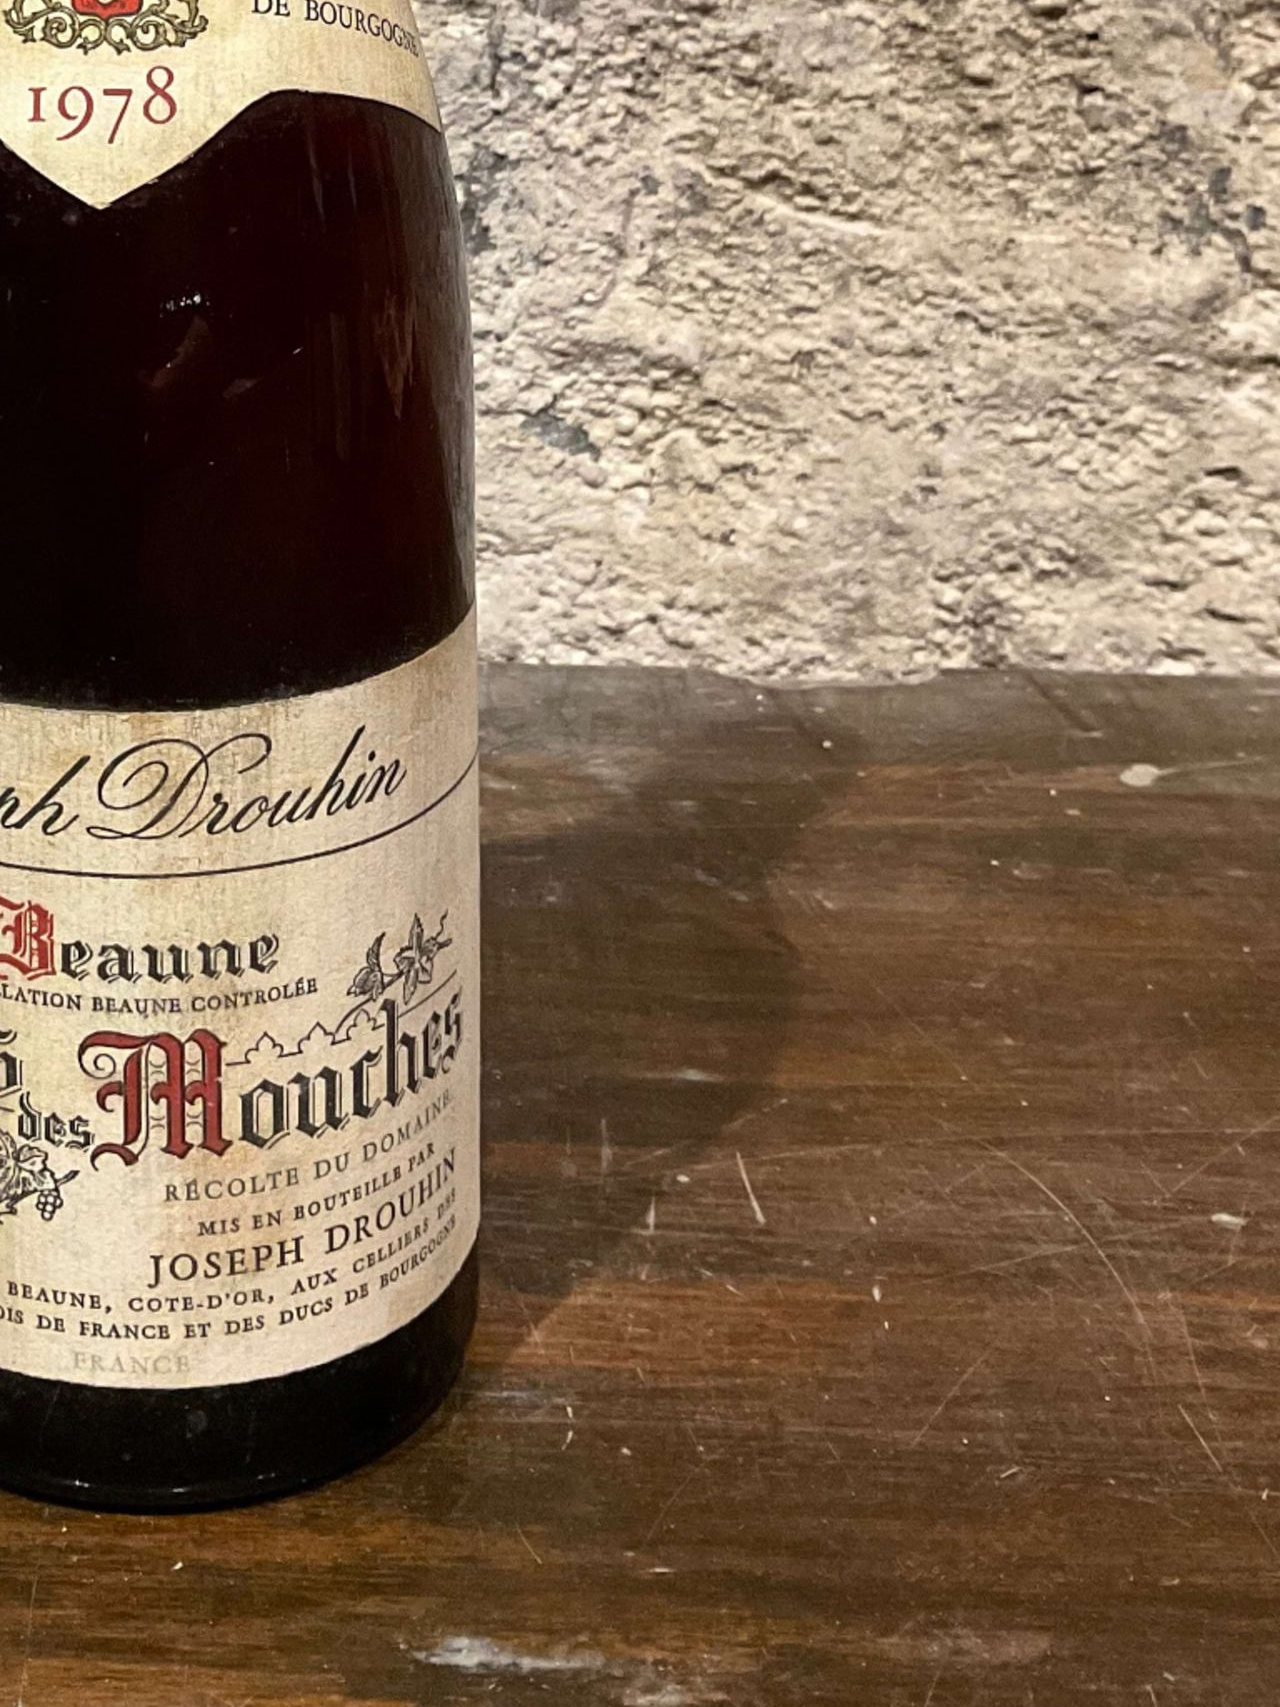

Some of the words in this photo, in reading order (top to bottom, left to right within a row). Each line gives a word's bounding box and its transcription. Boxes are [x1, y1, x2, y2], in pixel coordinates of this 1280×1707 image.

[27, 65, 177, 144] 1978
[86, 725, 407, 840] Drouhin
[91, 996, 182, 1013] BEAUNE
[191, 977, 319, 1012] CONTROLÉE
[18, 1091, 95, 1152] des
[313, 1151, 351, 1180] DU
[362, 1088, 452, 1162] DOMAINE
[147, 1235, 304, 1288] JOSEPH
[324, 1147, 456, 1254] DROUHIN
[197, 1217, 240, 1236] MIS
[252, 1210, 282, 1230] EN
[293, 1165, 402, 1221] BOUTEILLE
[408, 1142, 436, 1172] PAR
[7, 1280, 112, 1314] BEAUNE,
[291, 1268, 338, 1295] AUX
[352, 1217, 430, 1273] CELLIERS
[36, 1315, 65, 1332] DE
[79, 1321, 170, 1340] FRANCE
[184, 1322, 211, 1339] ET
[224, 1315, 265, 1335] DES
[278, 1297, 333, 1325] DUCS
[344, 1282, 369, 1306] DE
[379, 1214, 456, 1290] BOURGOGNE
[73, 1350, 191, 1375] FRANCE
